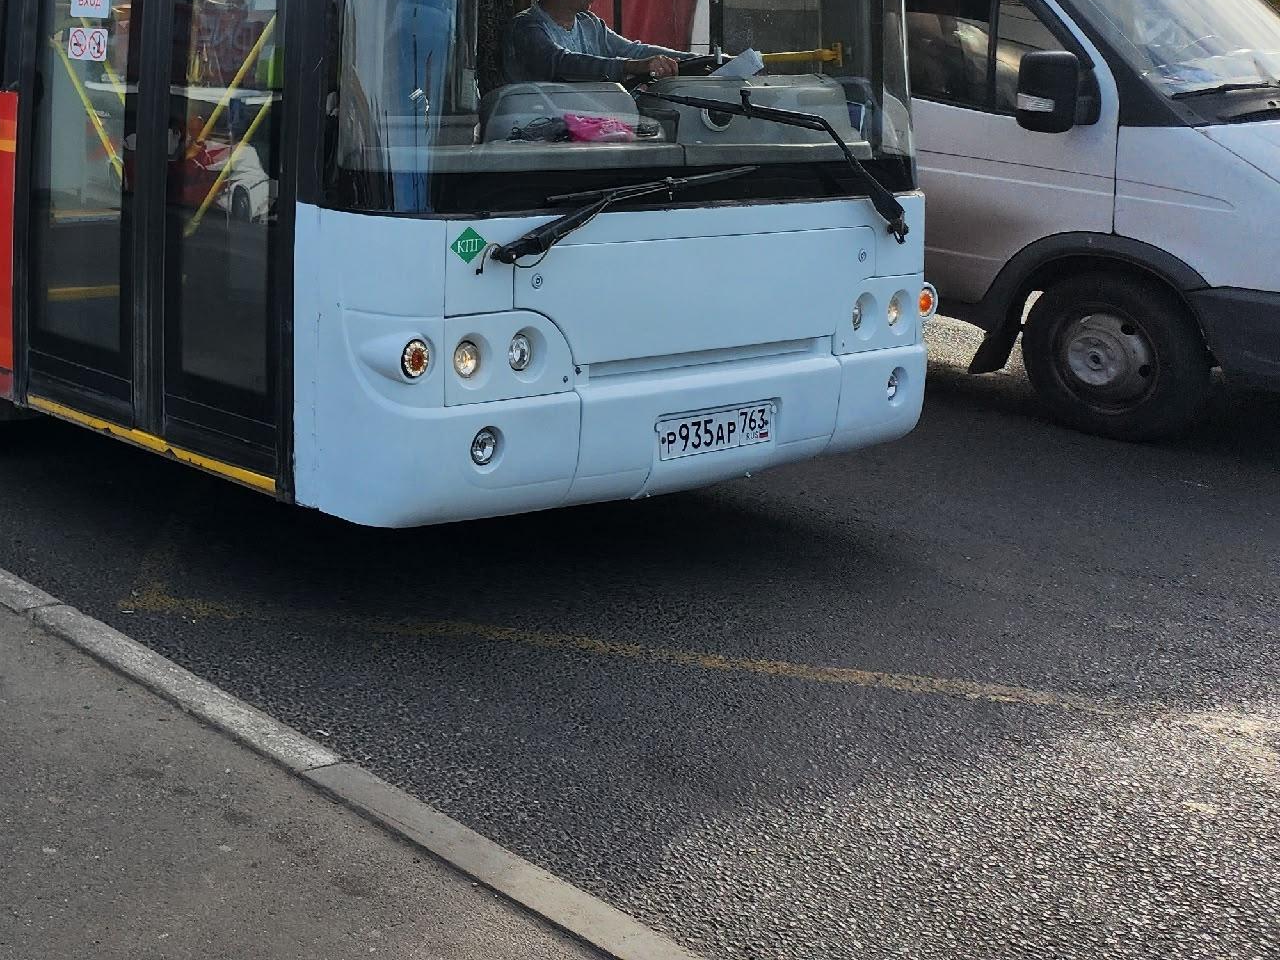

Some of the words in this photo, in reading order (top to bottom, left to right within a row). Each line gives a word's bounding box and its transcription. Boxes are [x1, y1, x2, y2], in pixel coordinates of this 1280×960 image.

[457, 239, 482, 253] КПГ
[739, 408, 766, 433] 763
[746, 430, 759, 440] RUS
